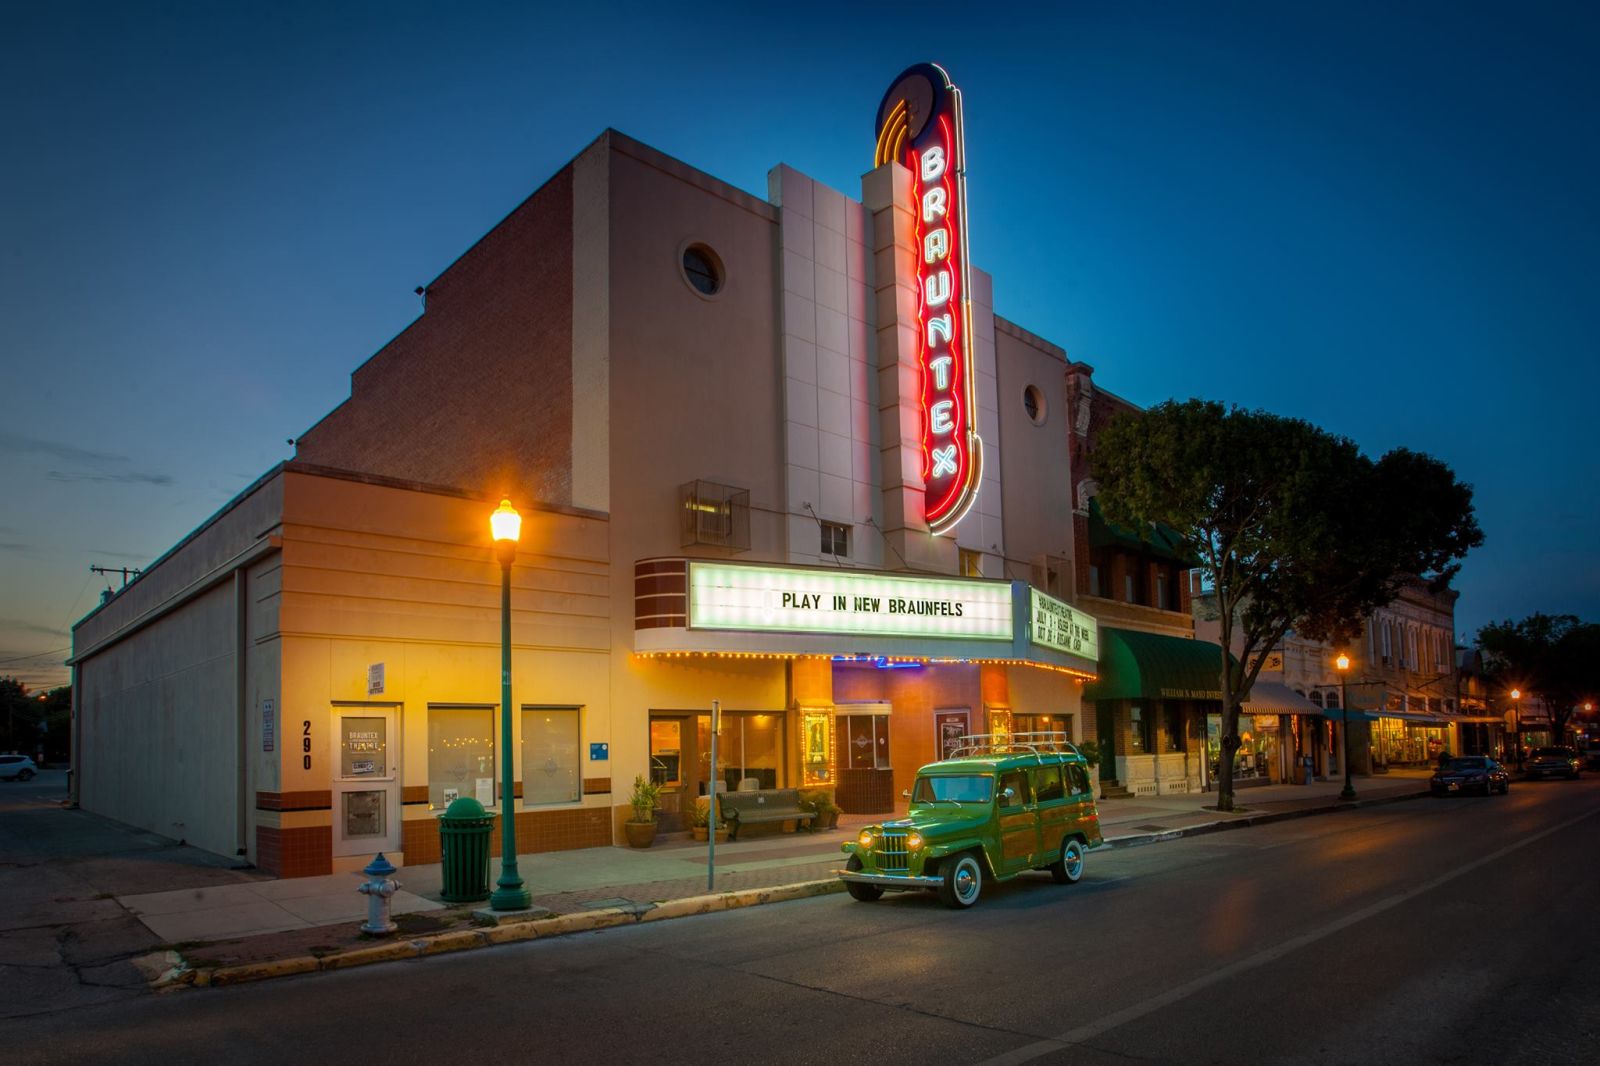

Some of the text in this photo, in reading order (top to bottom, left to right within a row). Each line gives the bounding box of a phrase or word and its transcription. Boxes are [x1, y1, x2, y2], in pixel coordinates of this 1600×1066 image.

[921, 146, 957, 478] BRAUNTEX
[782, 592, 963, 617] PLAY IN NEW BRAUNFELS
[303, 720, 311, 770] 290
[349, 731, 379, 740] BRAUNTEX
